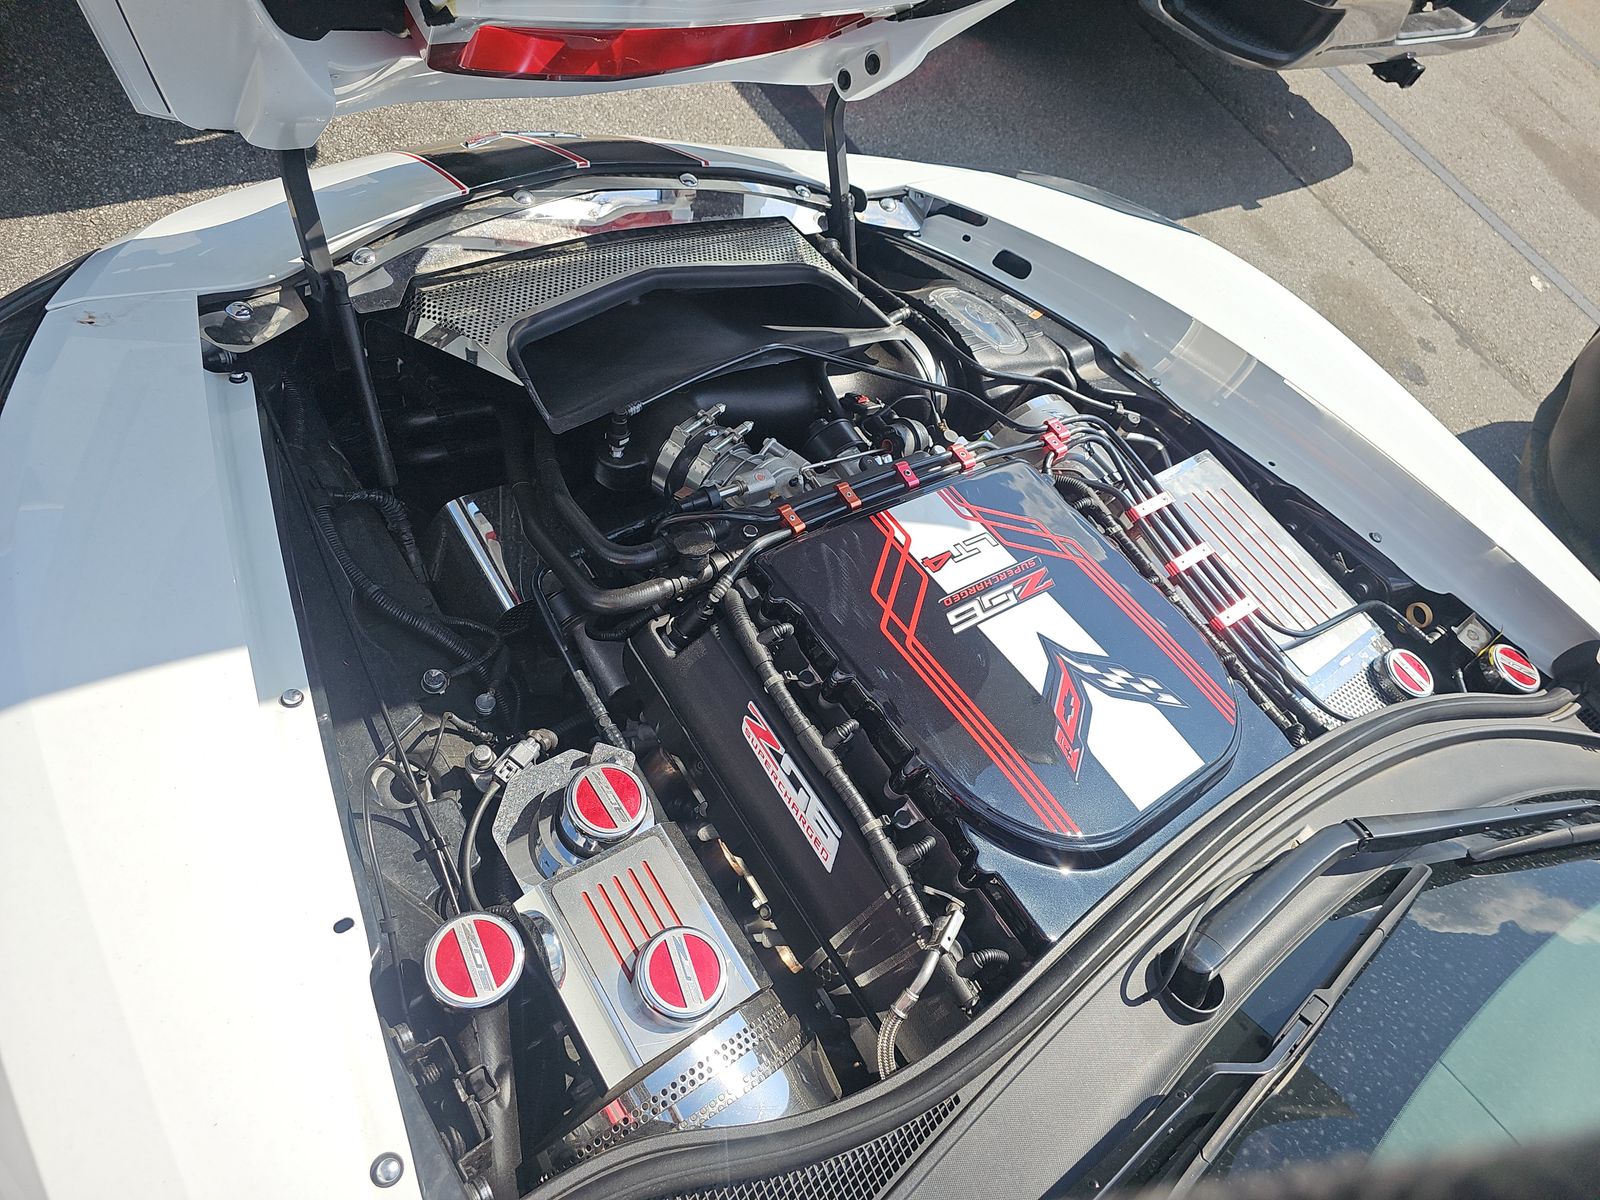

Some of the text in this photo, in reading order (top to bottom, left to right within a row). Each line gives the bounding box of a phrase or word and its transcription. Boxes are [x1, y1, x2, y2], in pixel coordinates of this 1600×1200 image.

[921, 532, 1000, 572] LT4
[942, 557, 1037, 607] SUPERCHARGED
[945, 567, 1055, 634] Z06
[743, 700, 843, 841] Z06
[744, 727, 830, 862] SUPERCHARGED
